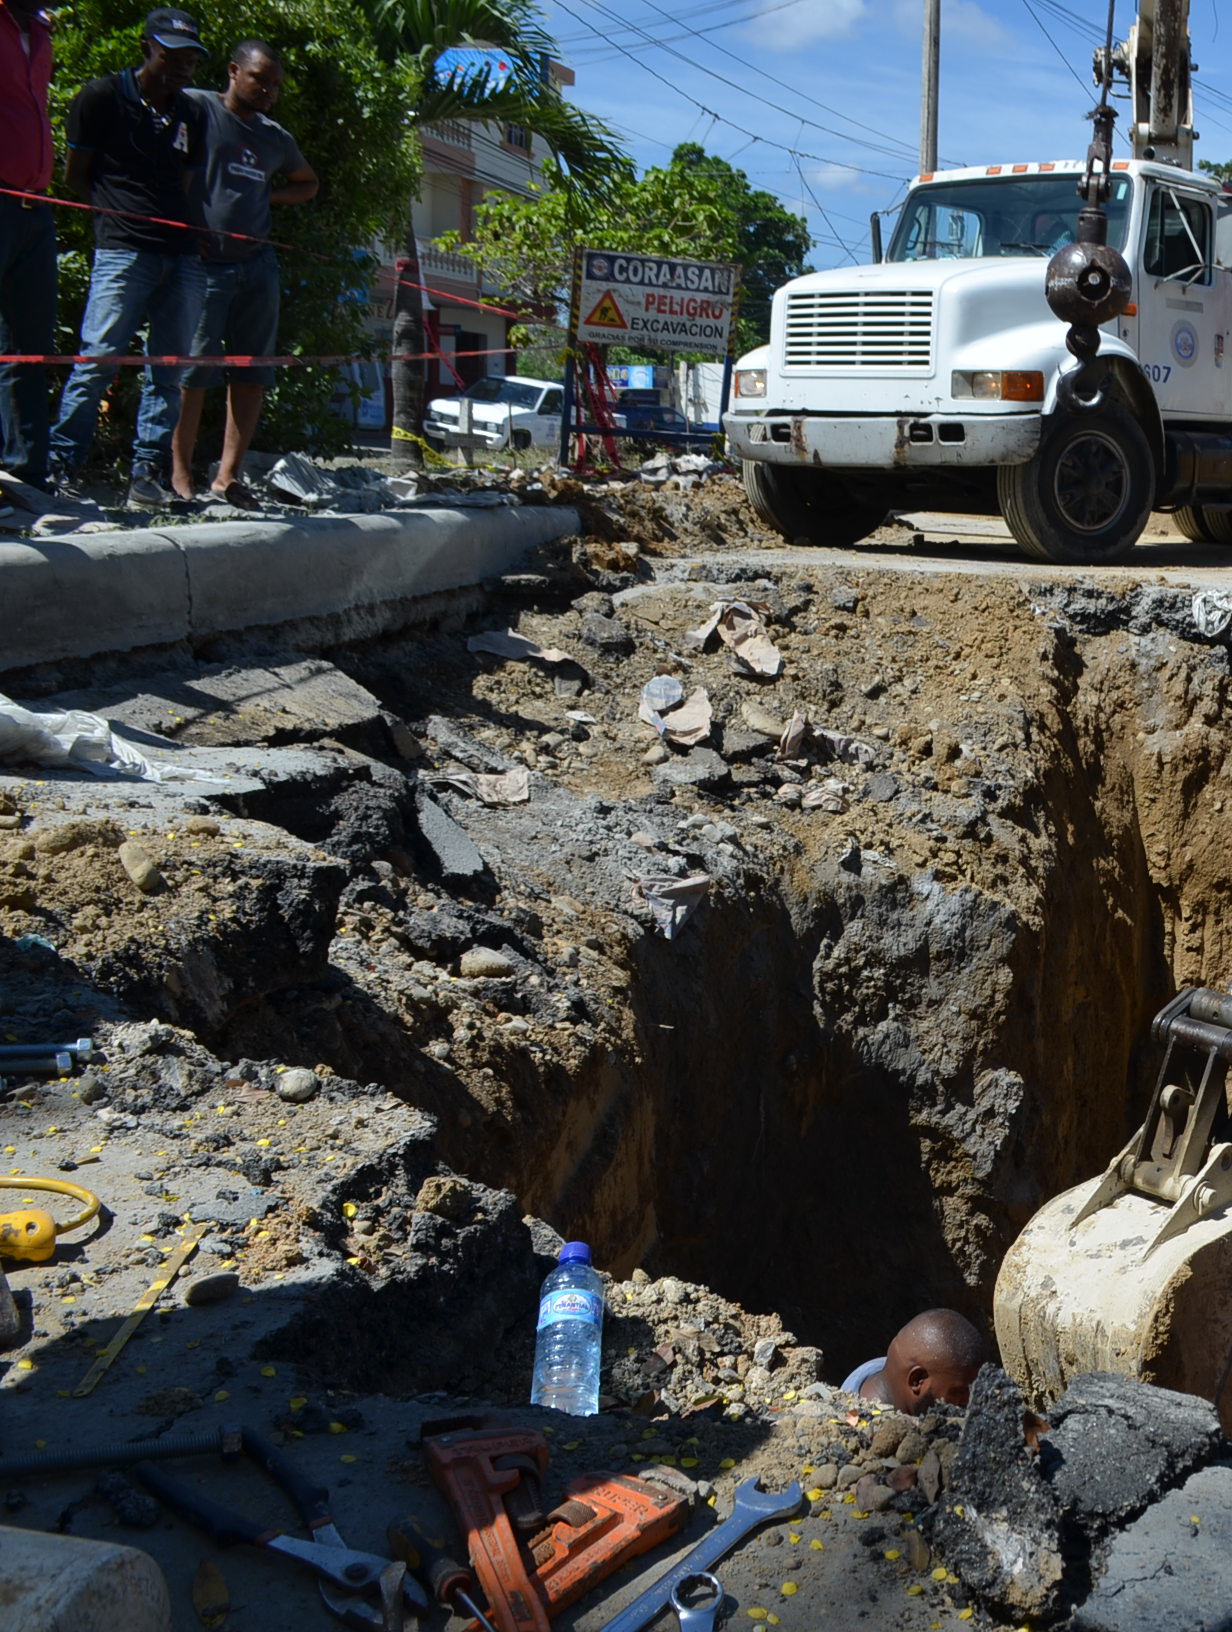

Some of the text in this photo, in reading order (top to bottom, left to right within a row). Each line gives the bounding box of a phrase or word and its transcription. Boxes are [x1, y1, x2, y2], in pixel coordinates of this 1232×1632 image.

[613, 258, 729, 293] CORAASAN
[645, 293, 724, 320] PELIGRO
[630, 317, 723, 339] EXCAVACION
